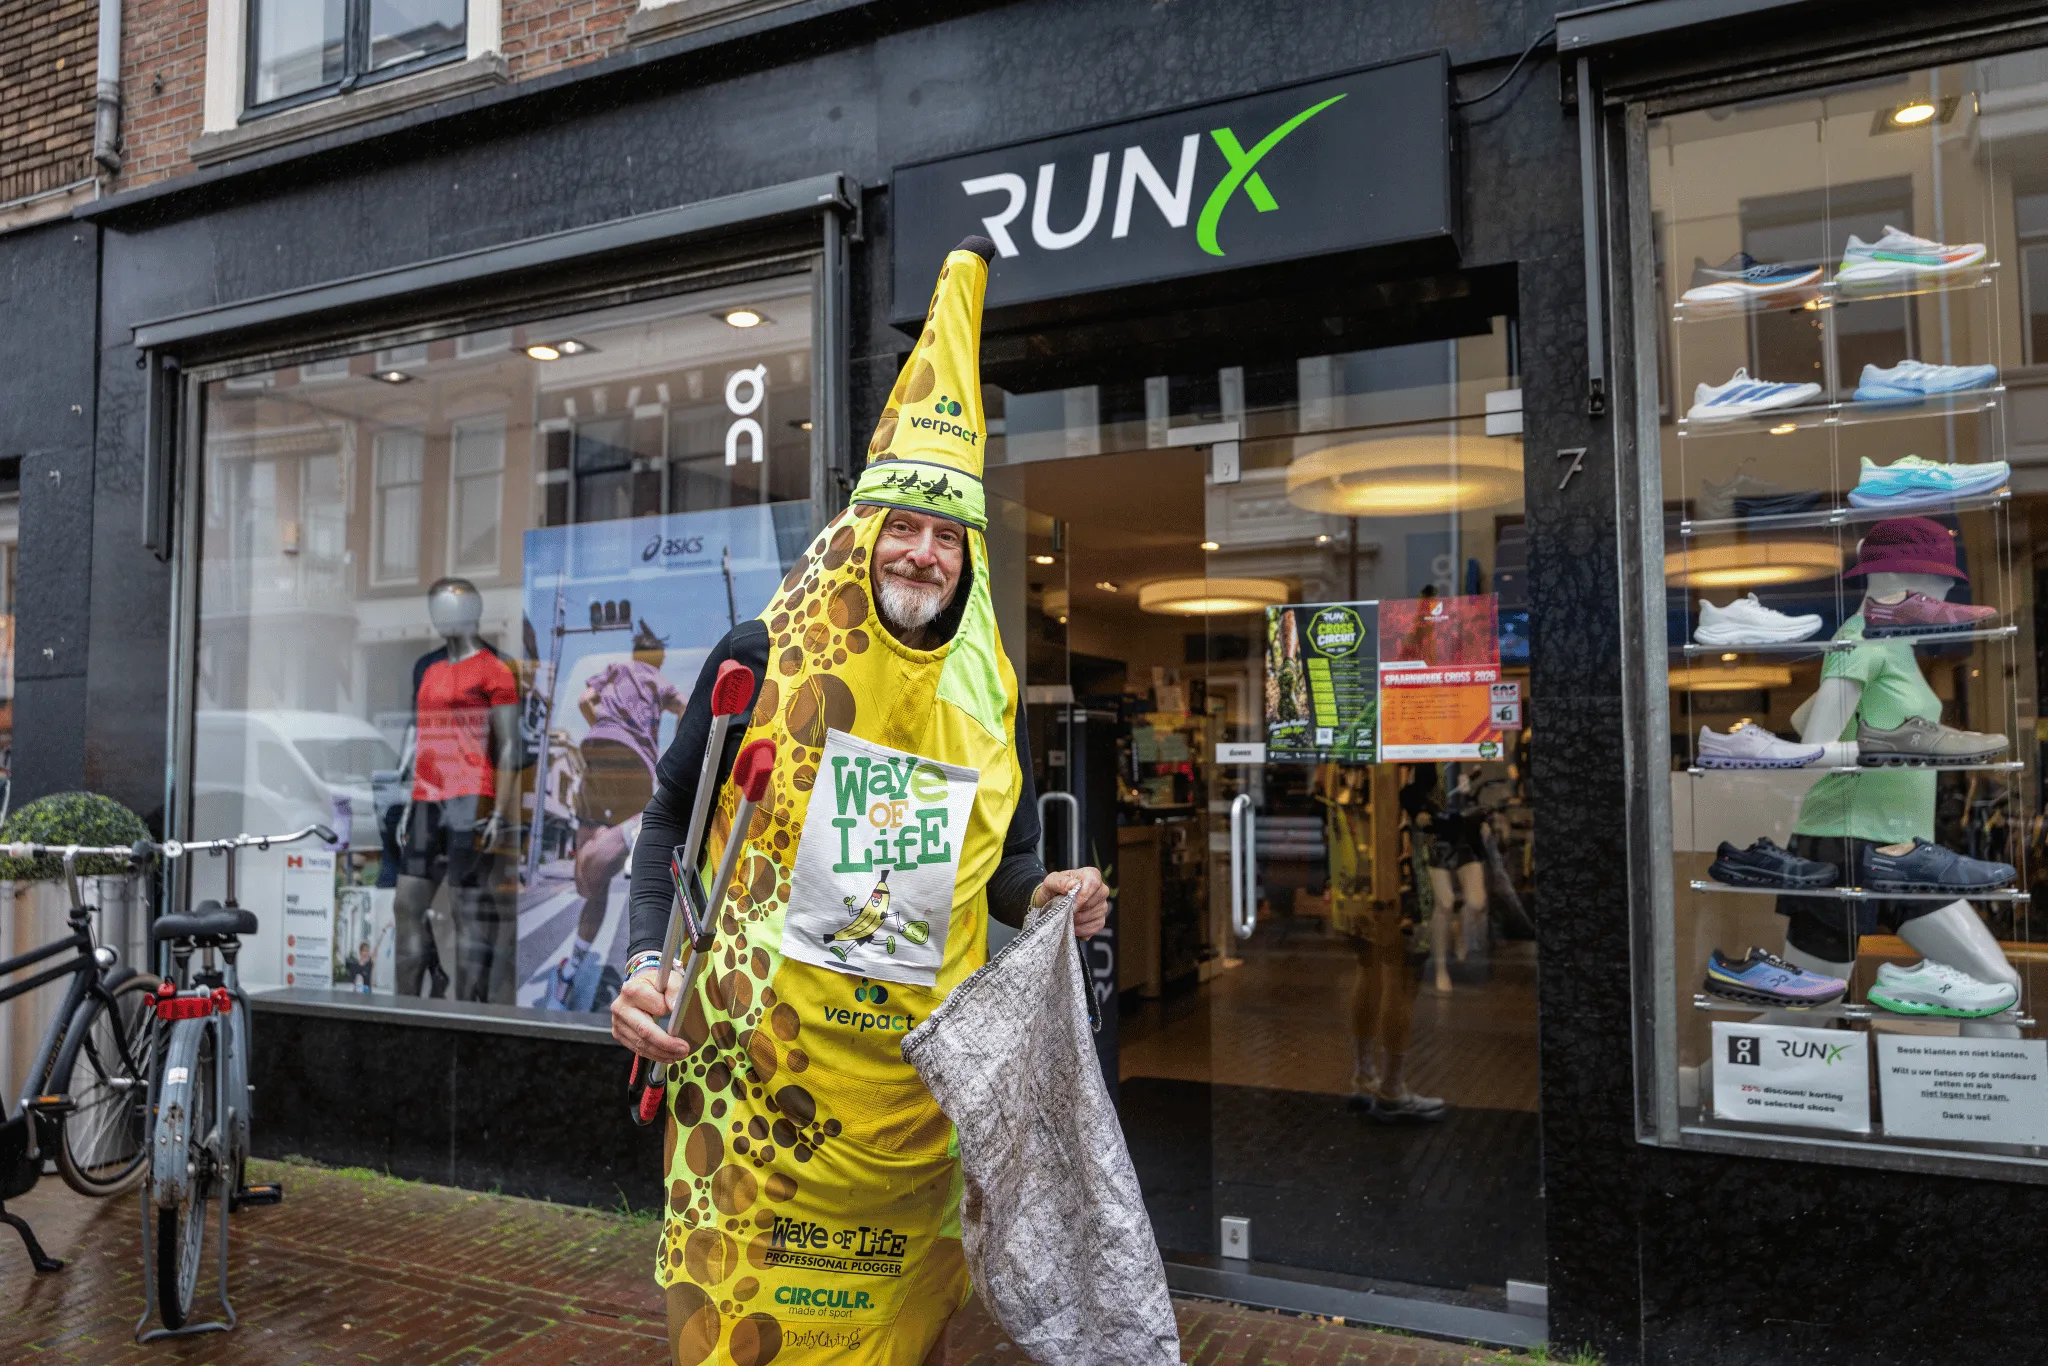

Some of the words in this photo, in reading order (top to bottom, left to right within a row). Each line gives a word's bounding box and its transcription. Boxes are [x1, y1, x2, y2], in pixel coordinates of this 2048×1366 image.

[961, 93, 1348, 258] RUNX
[911, 416, 978, 446] verpact
[1557, 447, 1587, 489] 7
[1317, 623, 1355, 635] CROSS
[1317, 632, 1356, 646] CIRCUIT
[1444, 671, 1471, 683] CROSS
[869, 800, 908, 828] OF
[824, 1005, 915, 1032] verpact
[1776, 1040, 1853, 1065] RUNX
[1897, 1046, 1922, 1054] Beste
[1924, 1048, 1957, 1056] klanten
[1972, 1049, 1989, 1057] niet
[1991, 1050, 2028, 1060] klanten,
[1892, 1067, 1909, 1075] Wilt
[1933, 1068, 1964, 1078] fietsen
[1966, 1071, 1977, 1080] op
[1978, 1070, 1989, 1079] de
[1991, 1071, 2037, 1081] standaard
[1934, 1080, 1961, 1088] zetten
[1976, 1081, 1993, 1089] aub
[1809, 1090, 1843, 1102] korting
[1921, 1089, 1938, 1098] niet
[1939, 1091, 1965, 1100] tegen
[1966, 1091, 1981, 1099] het
[1764, 1099, 1805, 1110] selected
[1807, 1104, 1836, 1113] shoes
[1942, 1111, 1965, 1120] Dank
[1974, 1113, 1991, 1121] wel
[832, 1230, 856, 1249] OF
[765, 1252, 848, 1270] PROFESSIONAL
[851, 1261, 901, 1274] PLOGGER
[774, 1286, 875, 1308] CIRCULR.
[788, 1306, 815, 1316] made
[817, 1307, 827, 1316] of
[829, 1309, 853, 1319] sport
